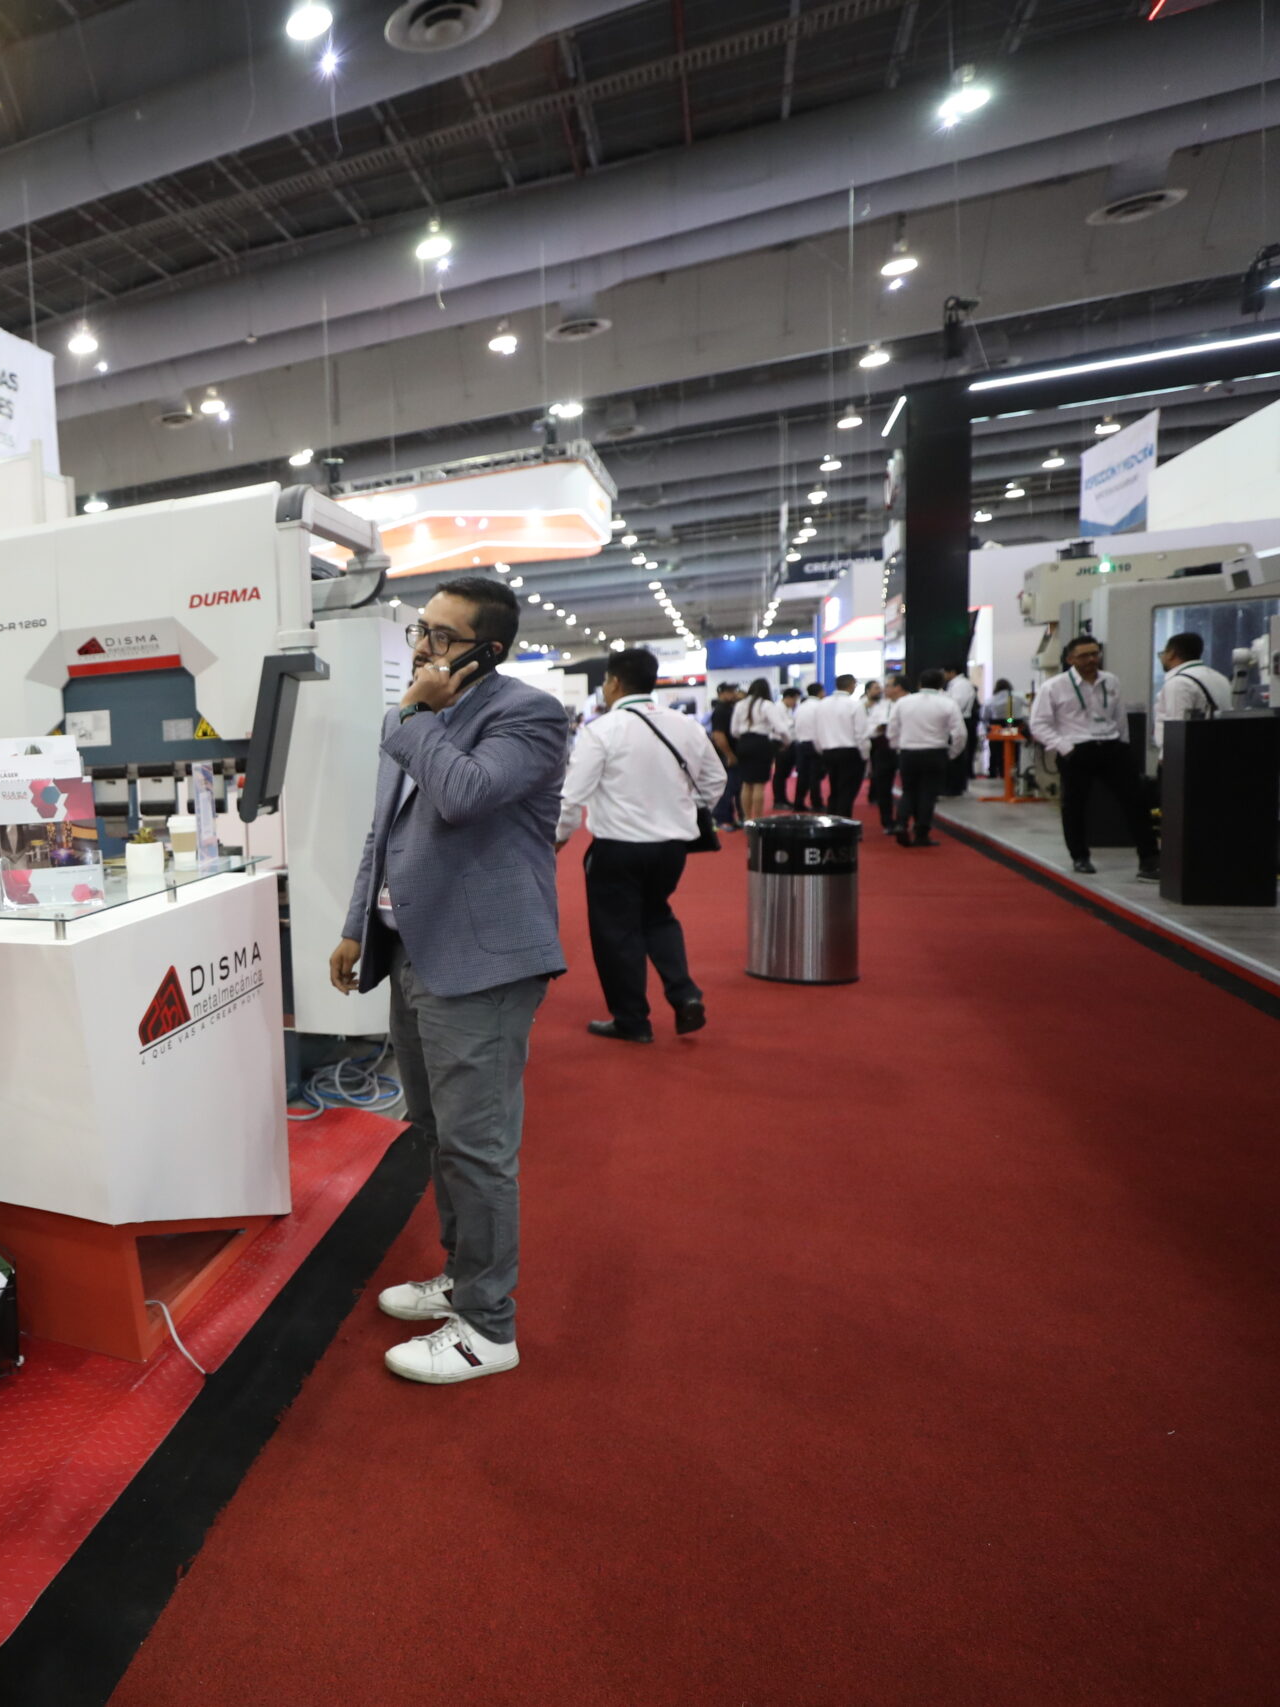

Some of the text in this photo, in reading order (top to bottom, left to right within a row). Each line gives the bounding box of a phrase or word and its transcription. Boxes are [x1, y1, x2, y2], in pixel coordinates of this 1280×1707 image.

[188, 586, 262, 609] DURMA
[18, 618, 47, 631] 1260
[105, 634, 158, 647] DISMA
[190, 941, 262, 996] DISMA
[193, 969, 263, 1018] metalmecánica
[178, 1027, 196, 1043] VAS
[201, 1022, 206, 1030] A
[210, 1003, 238, 1025] CREAR
